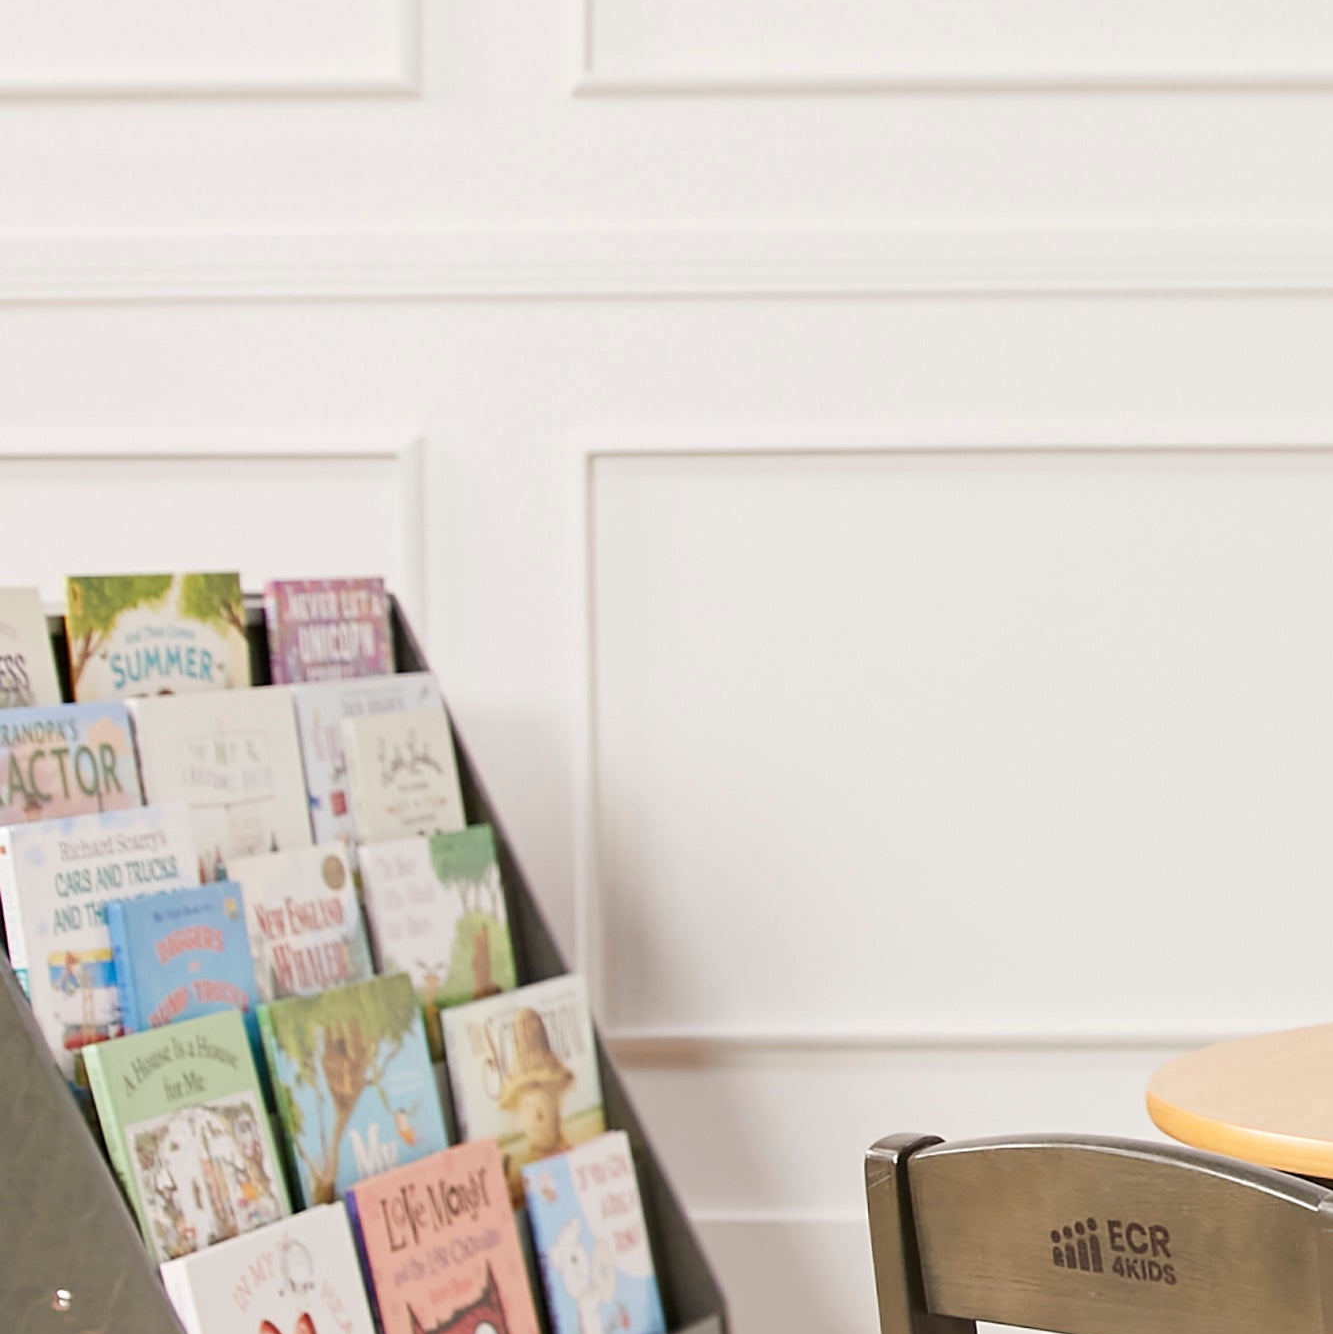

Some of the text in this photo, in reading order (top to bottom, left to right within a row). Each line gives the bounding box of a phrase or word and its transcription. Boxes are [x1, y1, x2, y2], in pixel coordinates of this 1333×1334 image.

[109, 643, 214, 690] SUMMER
[0, 743, 124, 808] ACTOR
[58, 835, 114, 861] Richard
[54, 868, 93, 898] CARS
[94, 862, 122, 891] AND
[123, 853, 178, 886] TRUCKS
[53, 904, 83, 937] AND
[1107, 1219, 1172, 1259] ECR
[1111, 1256, 1177, 1286] 4KIDS
